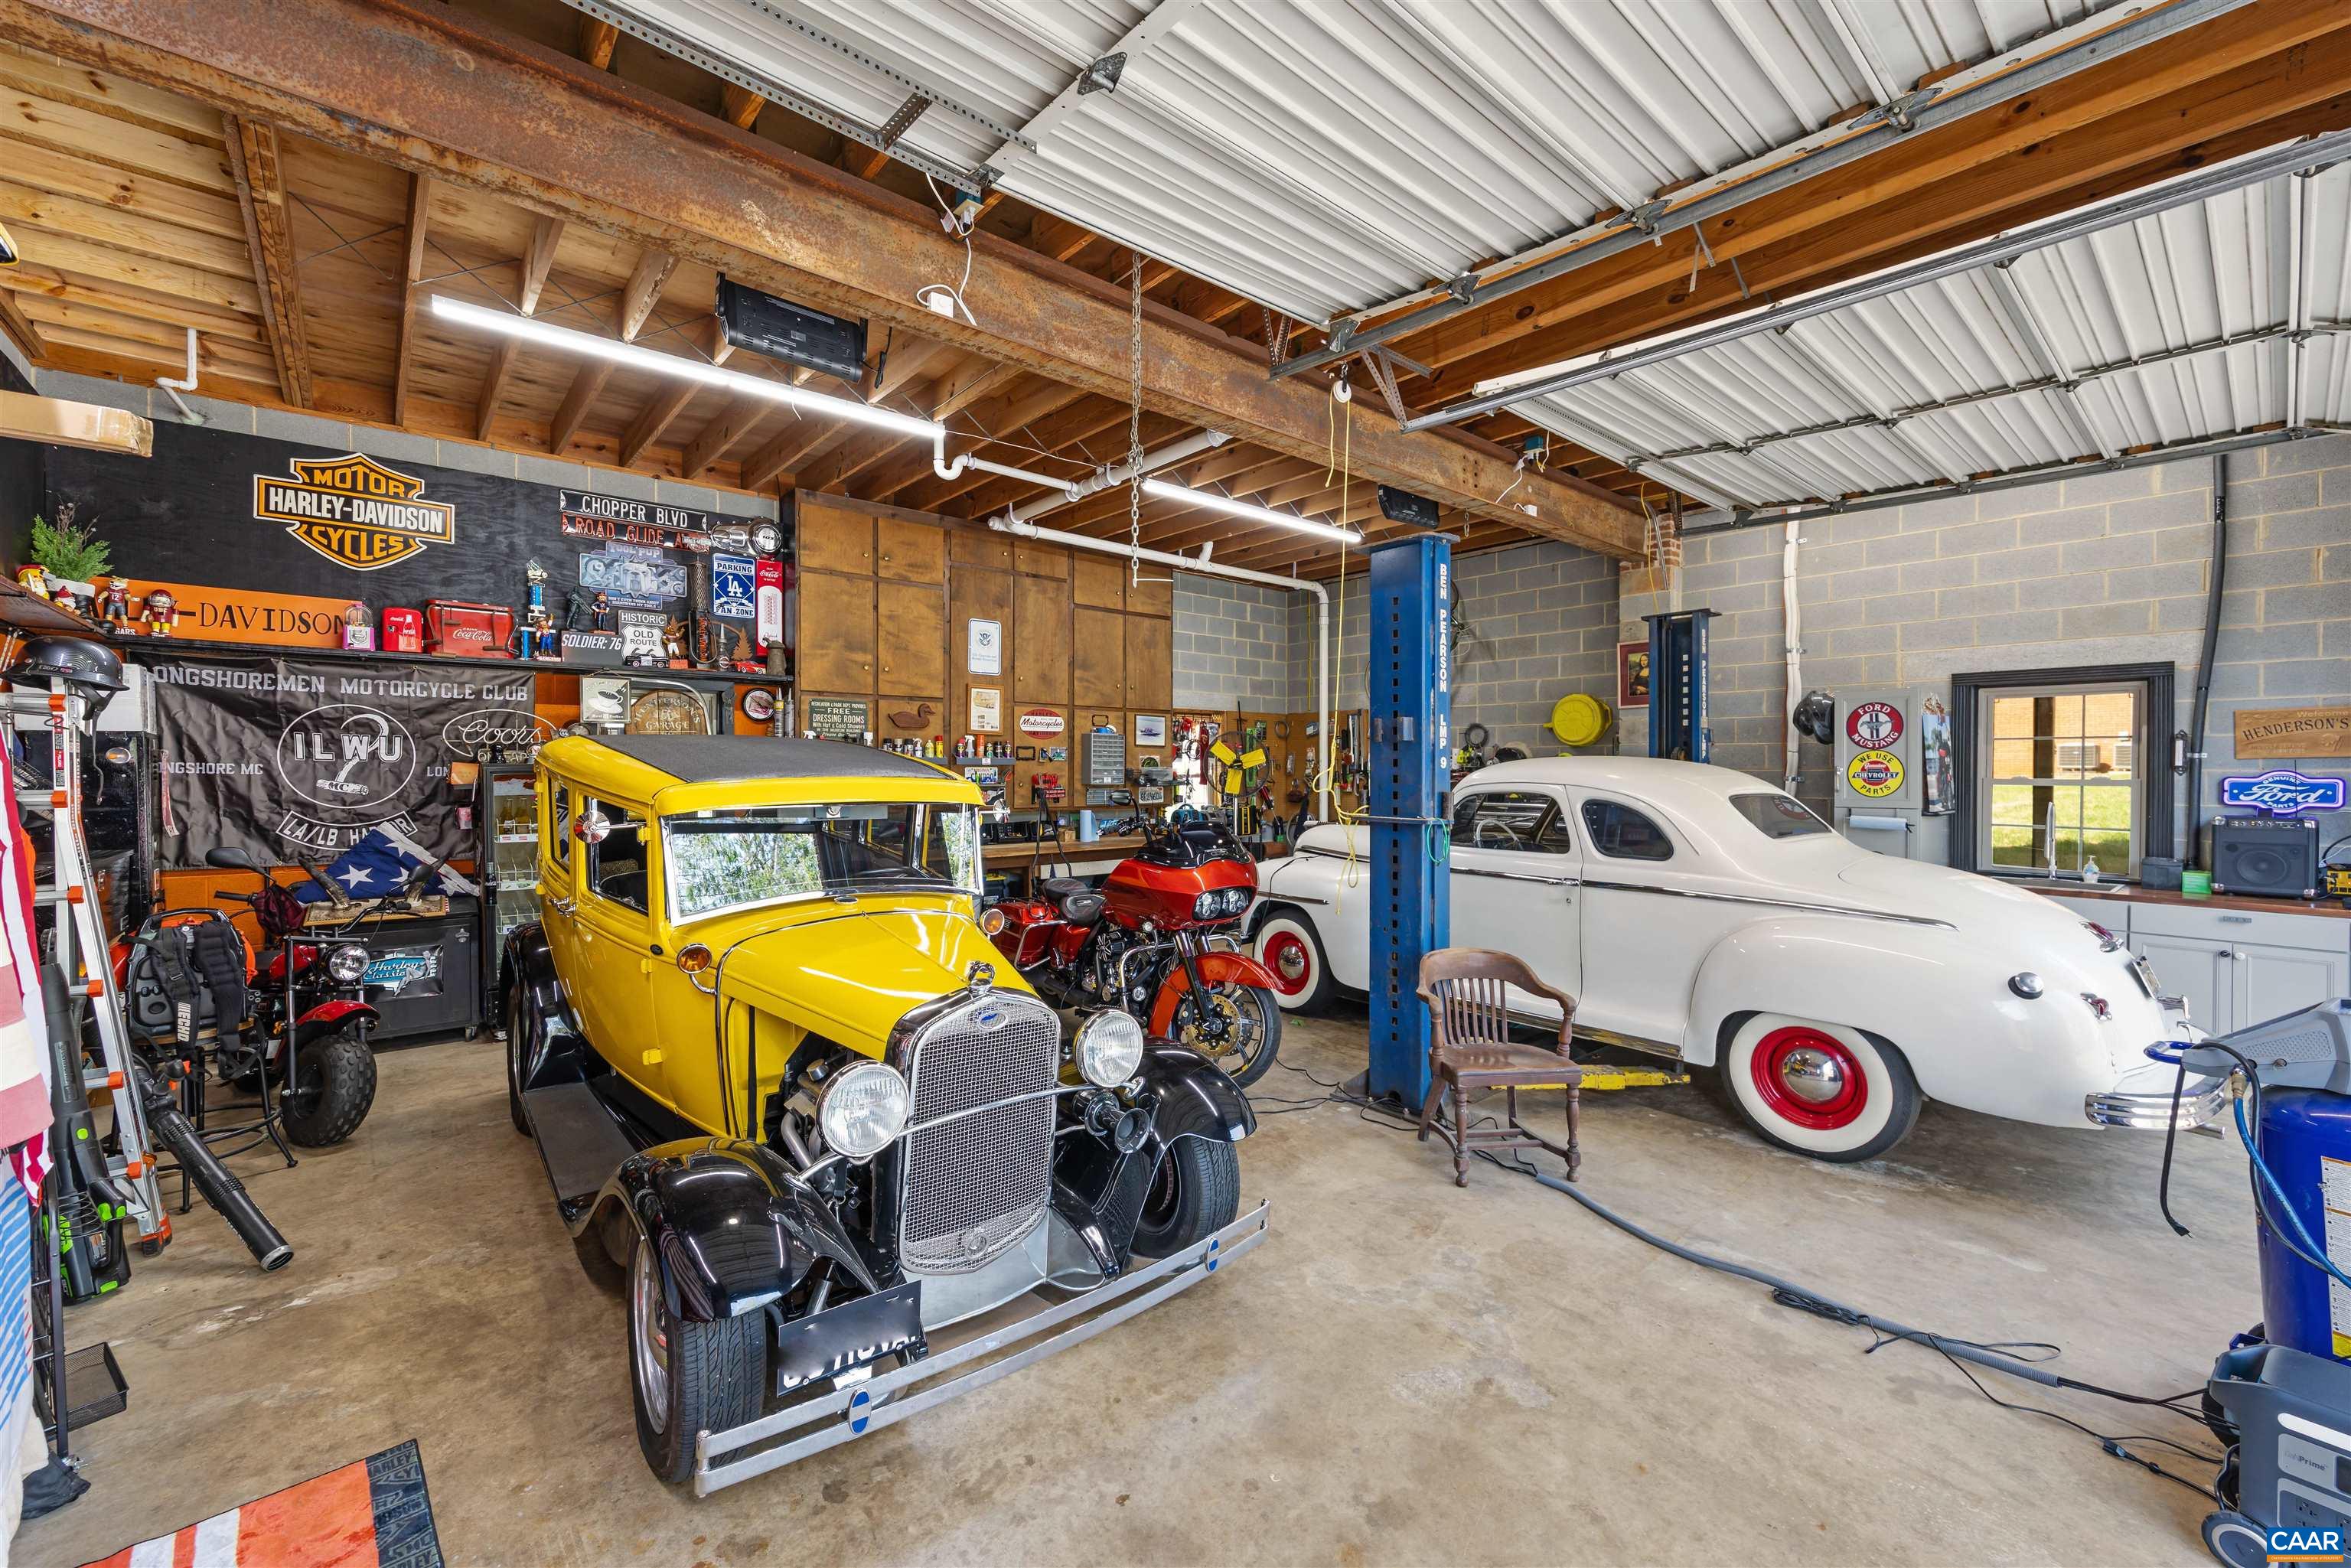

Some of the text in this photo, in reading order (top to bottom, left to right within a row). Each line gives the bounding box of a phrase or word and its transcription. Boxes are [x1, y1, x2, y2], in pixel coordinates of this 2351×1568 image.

[314, 465, 405, 497] MOTOR
[269, 487, 443, 533] HARLEY-DAVIDSON
[582, 496, 688, 527] CHOPPER BLVD
[576, 518, 615, 538] ROAD
[627, 525, 664, 546] GLIDE
[311, 526, 404, 561] CYCLES
[609, 543, 660, 557] TOOL PUP
[716, 562, 752, 573] PARKING
[727, 575, 743, 597] LA
[716, 605, 754, 616] FAN ZONE
[199, 601, 345, 636] DAVIDSON
[621, 613, 664, 624] HISTORIC
[453, 628, 494, 642] Coca-Cola
[634, 630, 654, 639] OLD
[562, 634, 622, 650] SOLDIER: 76
[630, 638, 657, 647] ROUTE
[154, 667, 528, 701] ONGSHOREMEN MOTORCYCLE CLUB
[1858, 703, 1891, 716] FORD
[813, 713, 865, 724] DRESSING ROOMS
[1021, 718, 1062, 729] Motorcycles
[458, 719, 542, 744] Coors
[646, 722, 690, 730] GARAGE
[2242, 717, 2349, 741] HENDERSON'S
[1851, 731, 1899, 748] MUSTANG
[1440, 756, 1447, 769] 9
[1857, 753, 1894, 764] WE USE
[159, 762, 263, 775] NGSHORE MC
[2263, 776, 2301, 784] GENUINE
[1860, 784, 1891, 795] PARTS
[2239, 783, 2324, 803] Ford
[283, 818, 338, 846] LA/LB
[368, 960, 420, 973] Harley
[364, 970, 406, 980] Classic
[178, 1012, 191, 1042] ECHO
